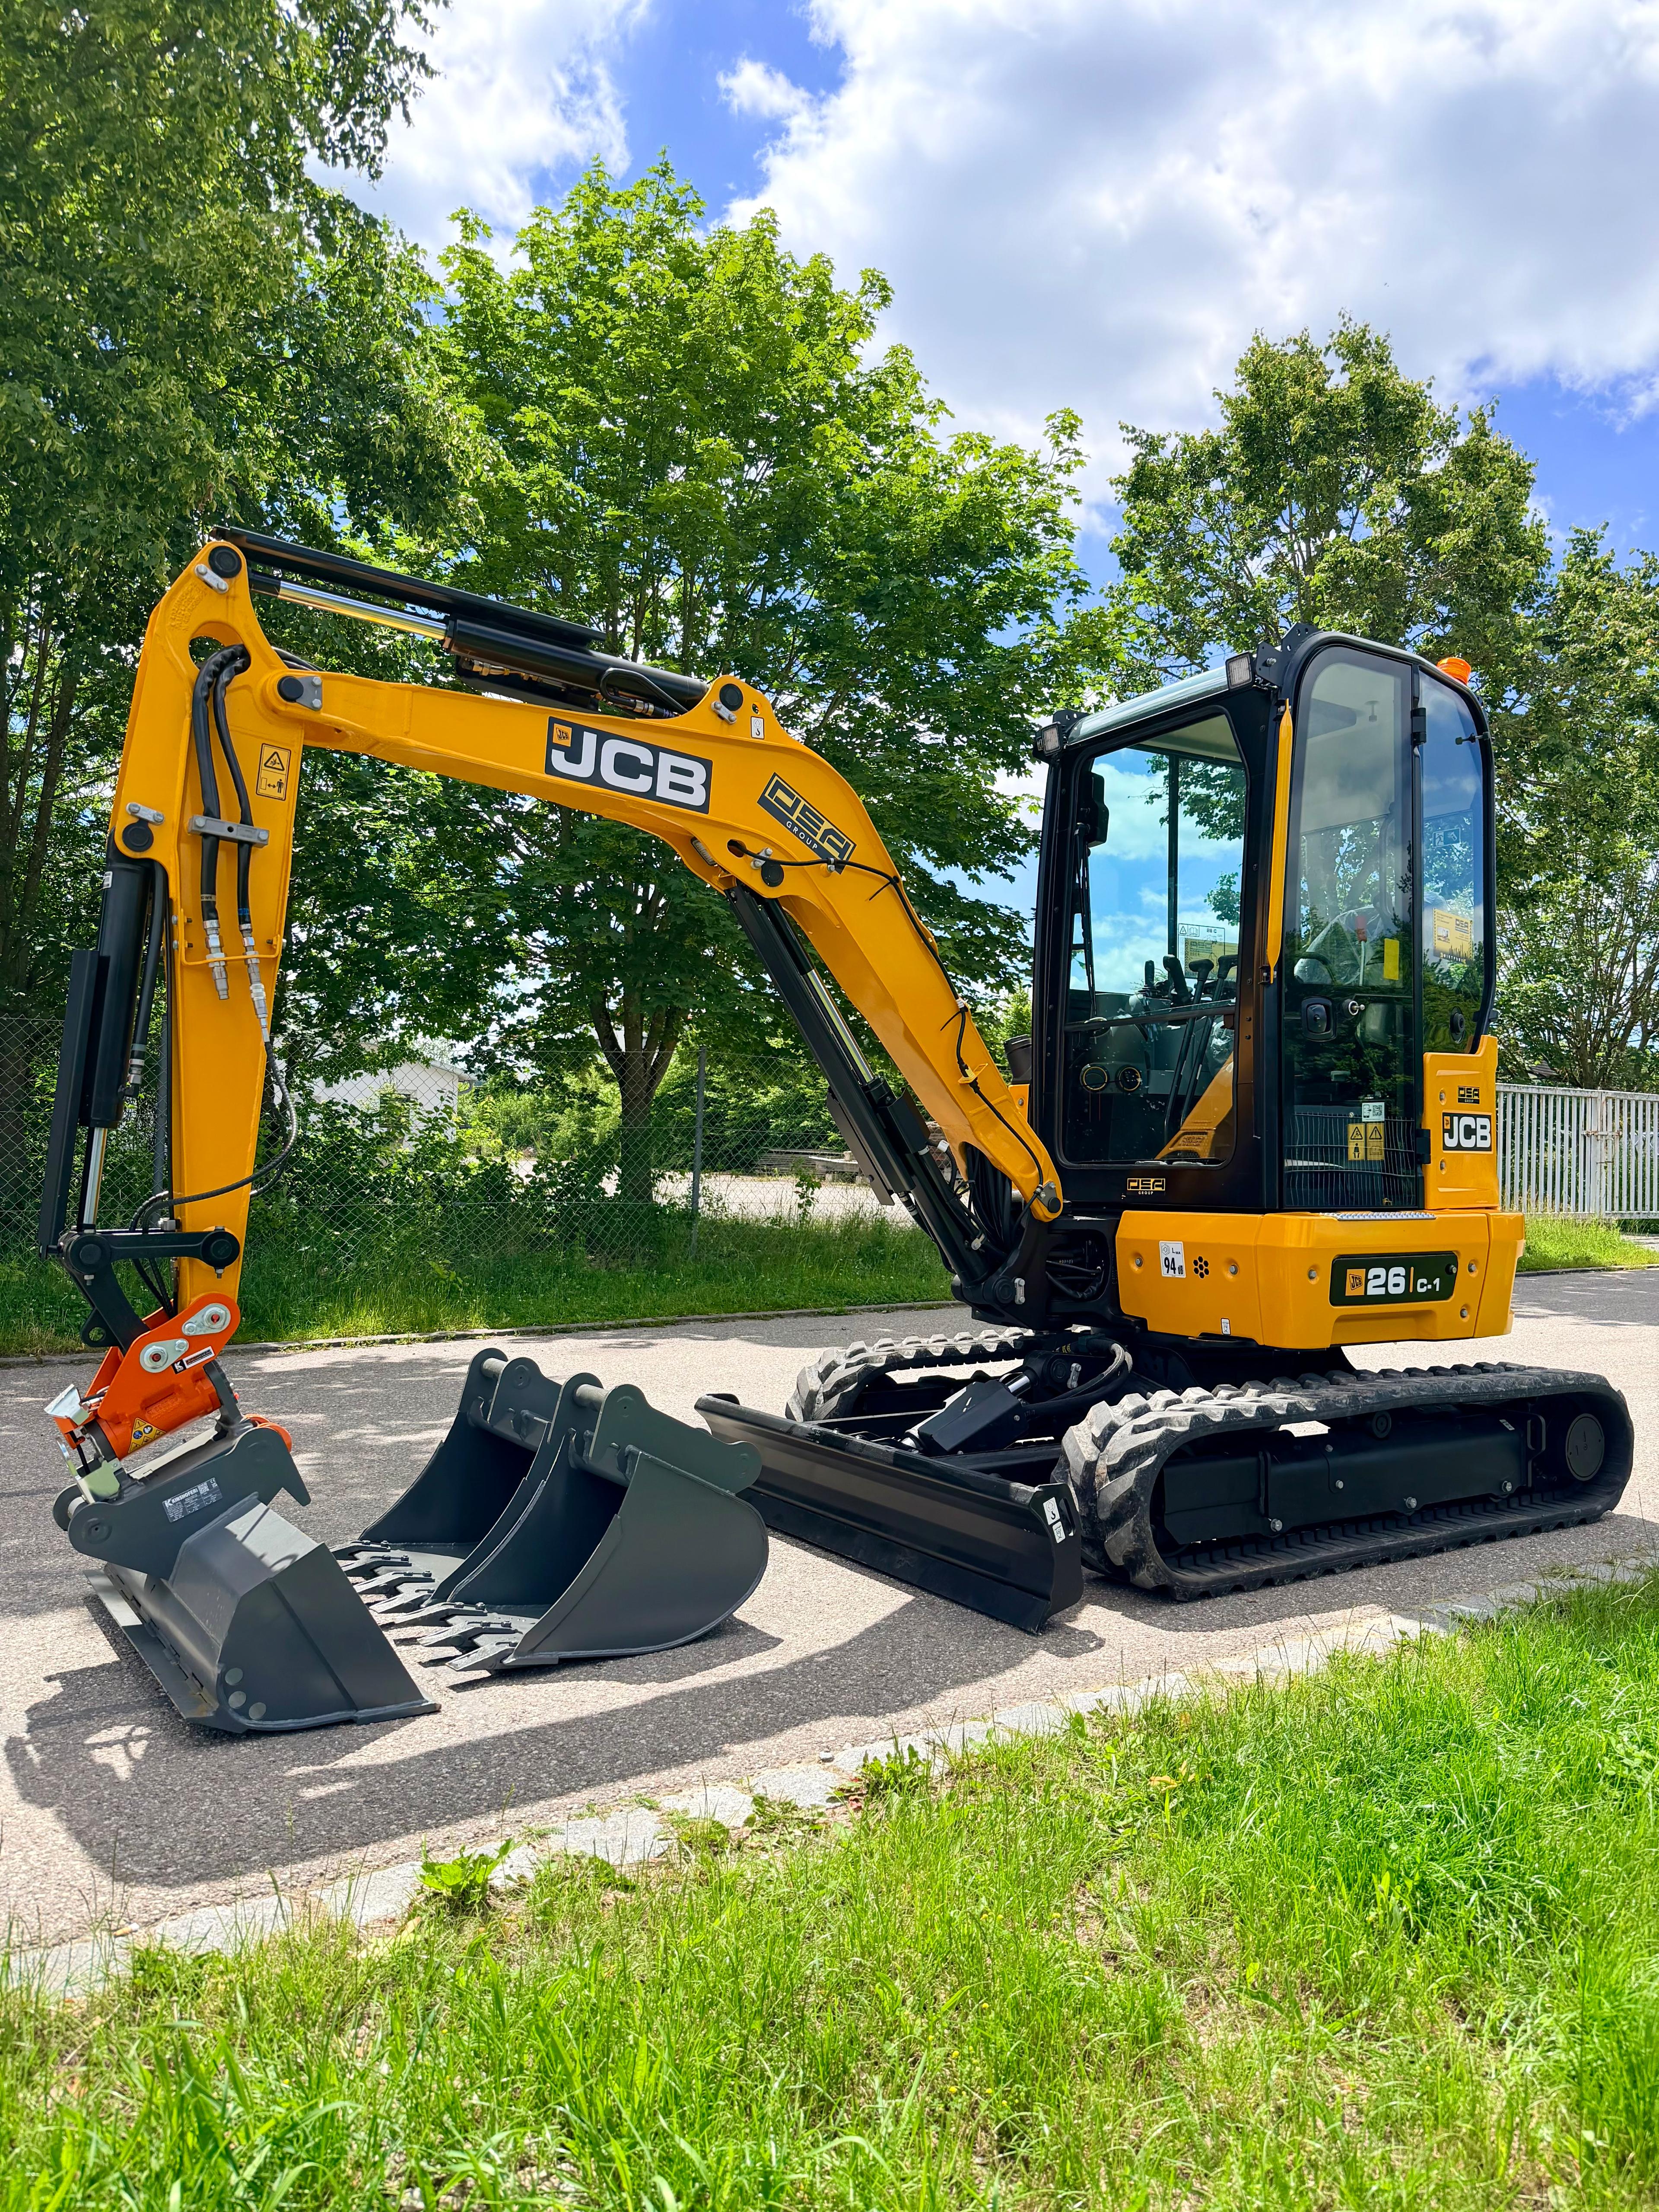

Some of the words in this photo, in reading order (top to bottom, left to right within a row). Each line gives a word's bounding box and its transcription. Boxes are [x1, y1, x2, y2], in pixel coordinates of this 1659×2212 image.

[558, 728, 569, 739] JCB
[551, 731, 706, 806] JCB
[786, 821, 818, 849] GROUP
[1444, 1116, 1491, 1148] JCB
[1164, 1257, 1176, 1274] 94
[1351, 1275, 1363, 1288] JCB
[1367, 1267, 1405, 1295] 26
[1417, 1278, 1440, 1293] C-1
